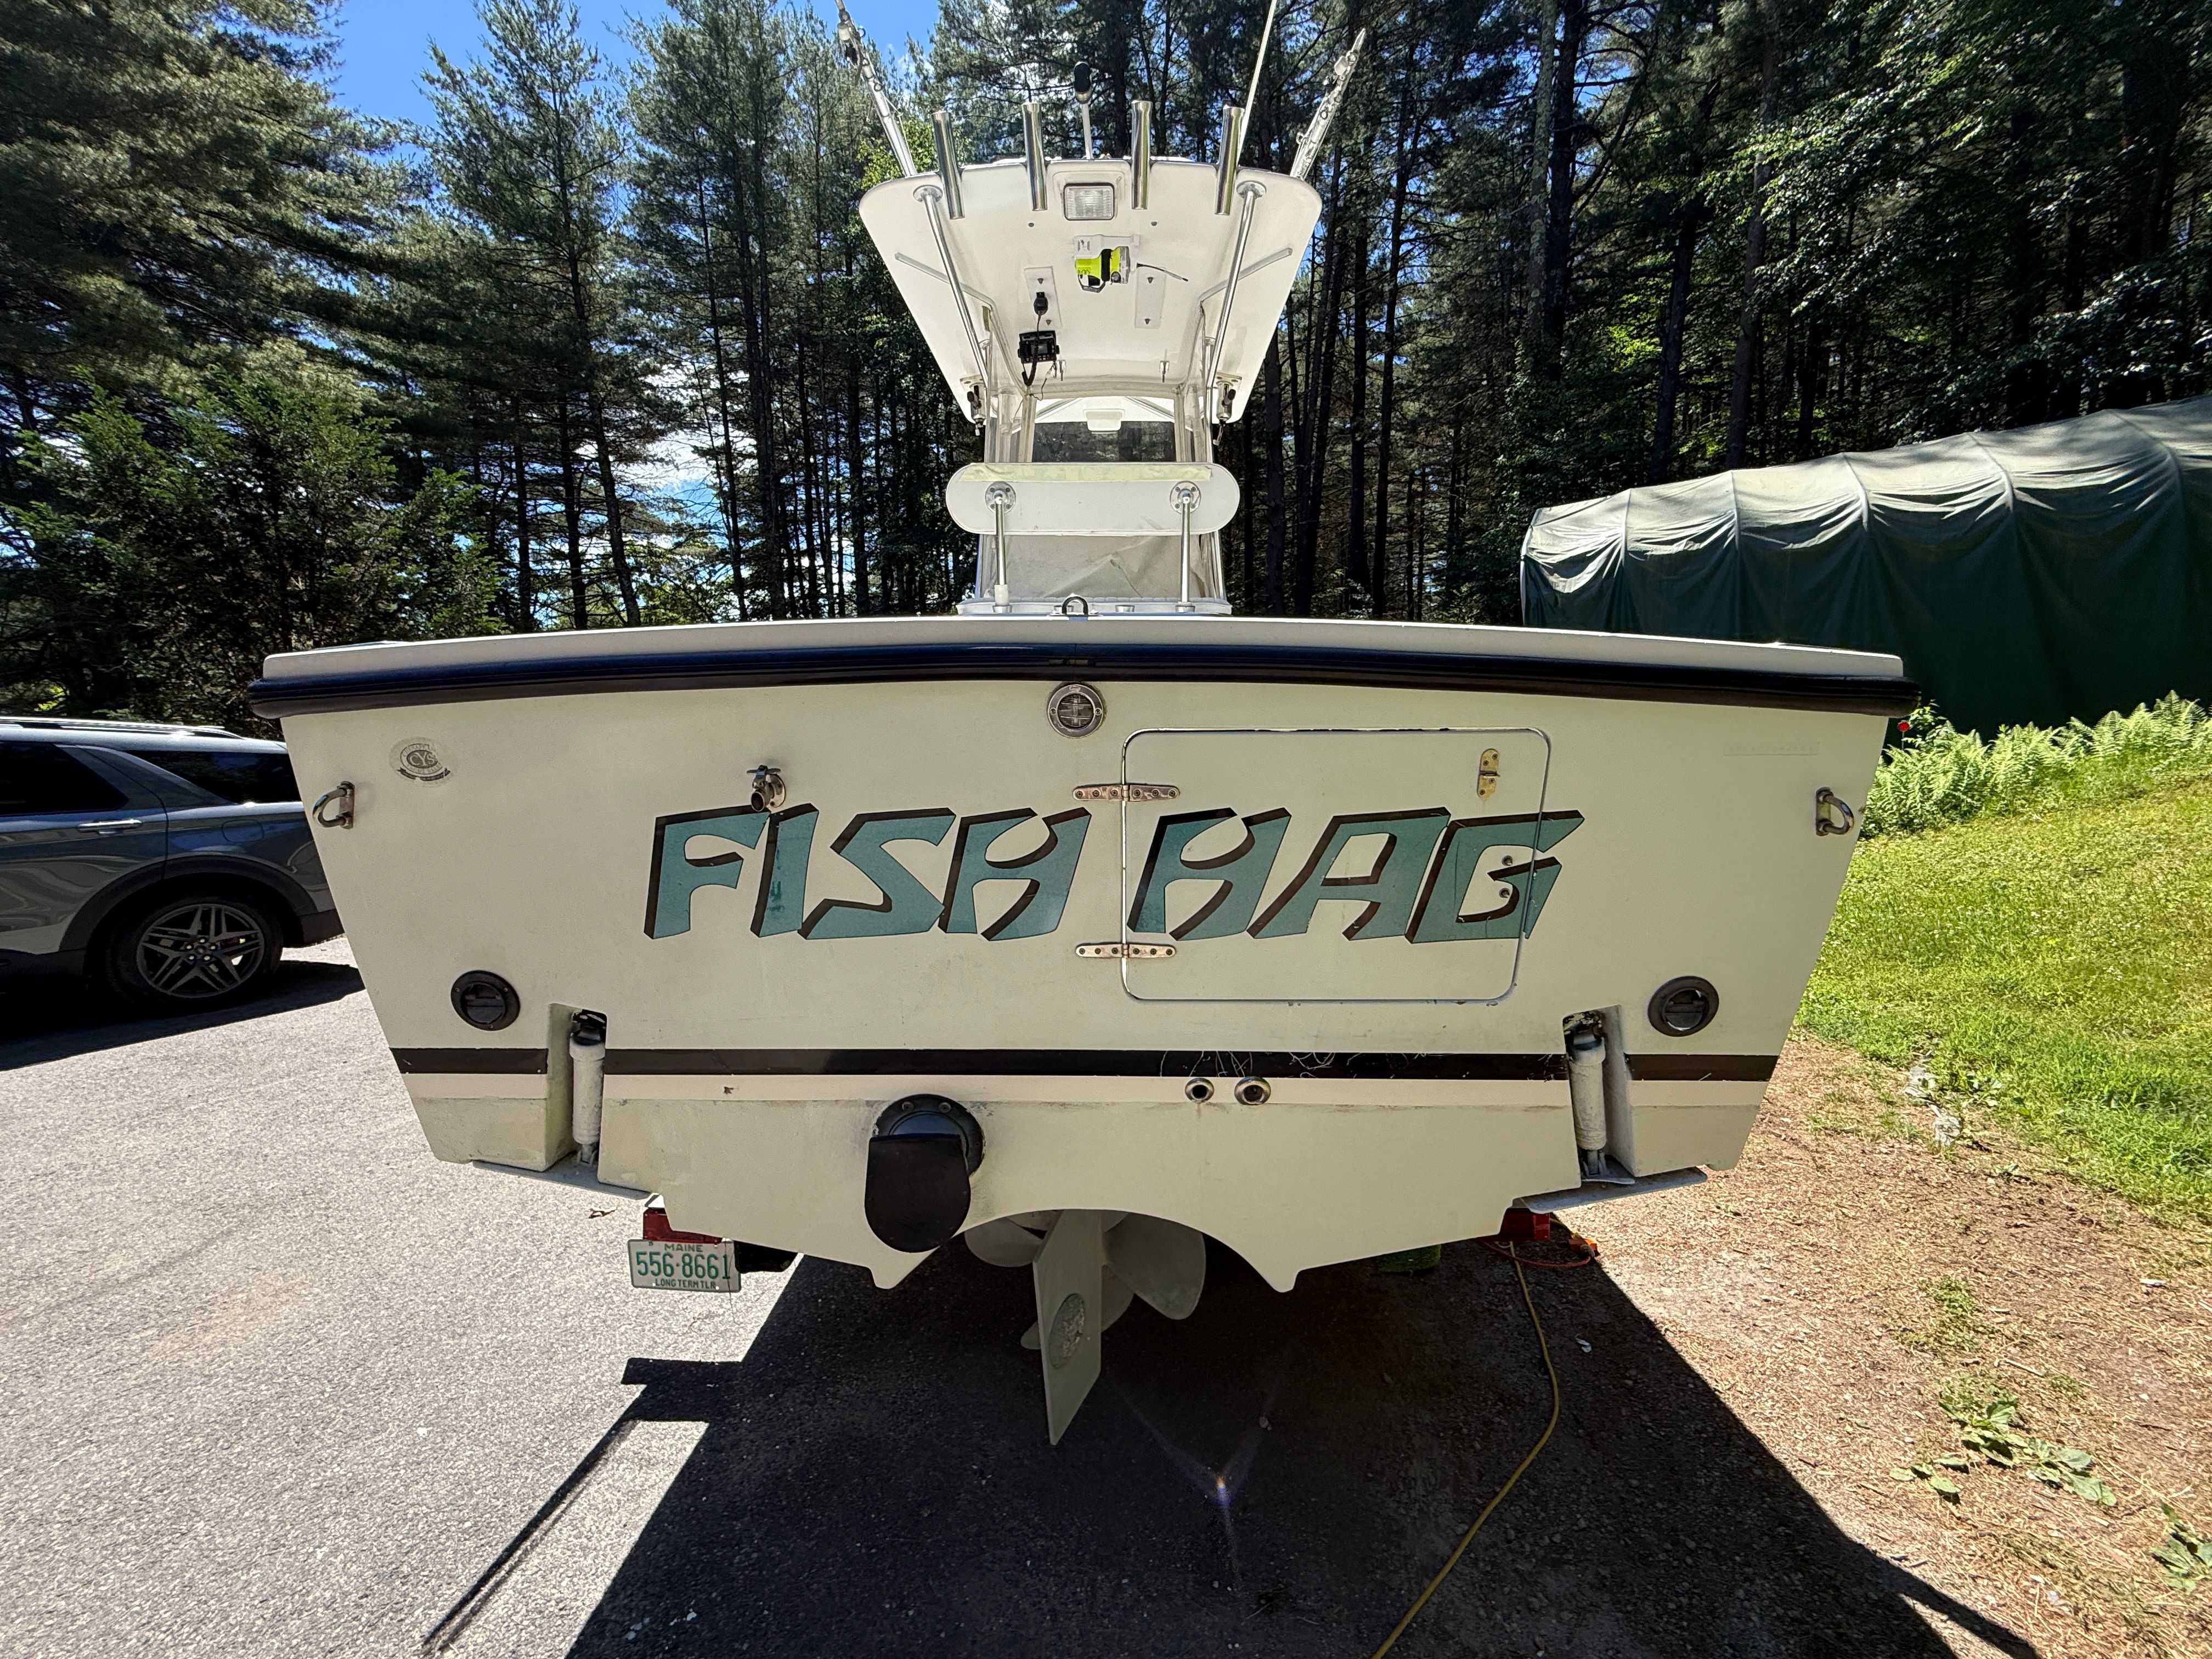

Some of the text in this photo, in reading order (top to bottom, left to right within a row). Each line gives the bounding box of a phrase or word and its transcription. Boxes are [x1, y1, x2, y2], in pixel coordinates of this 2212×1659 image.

[644, 803, 1585, 944] FISH HAG
[664, 1244, 703, 1252] MAINE
[655, 1278, 716, 1289] LONG TERM TLR
